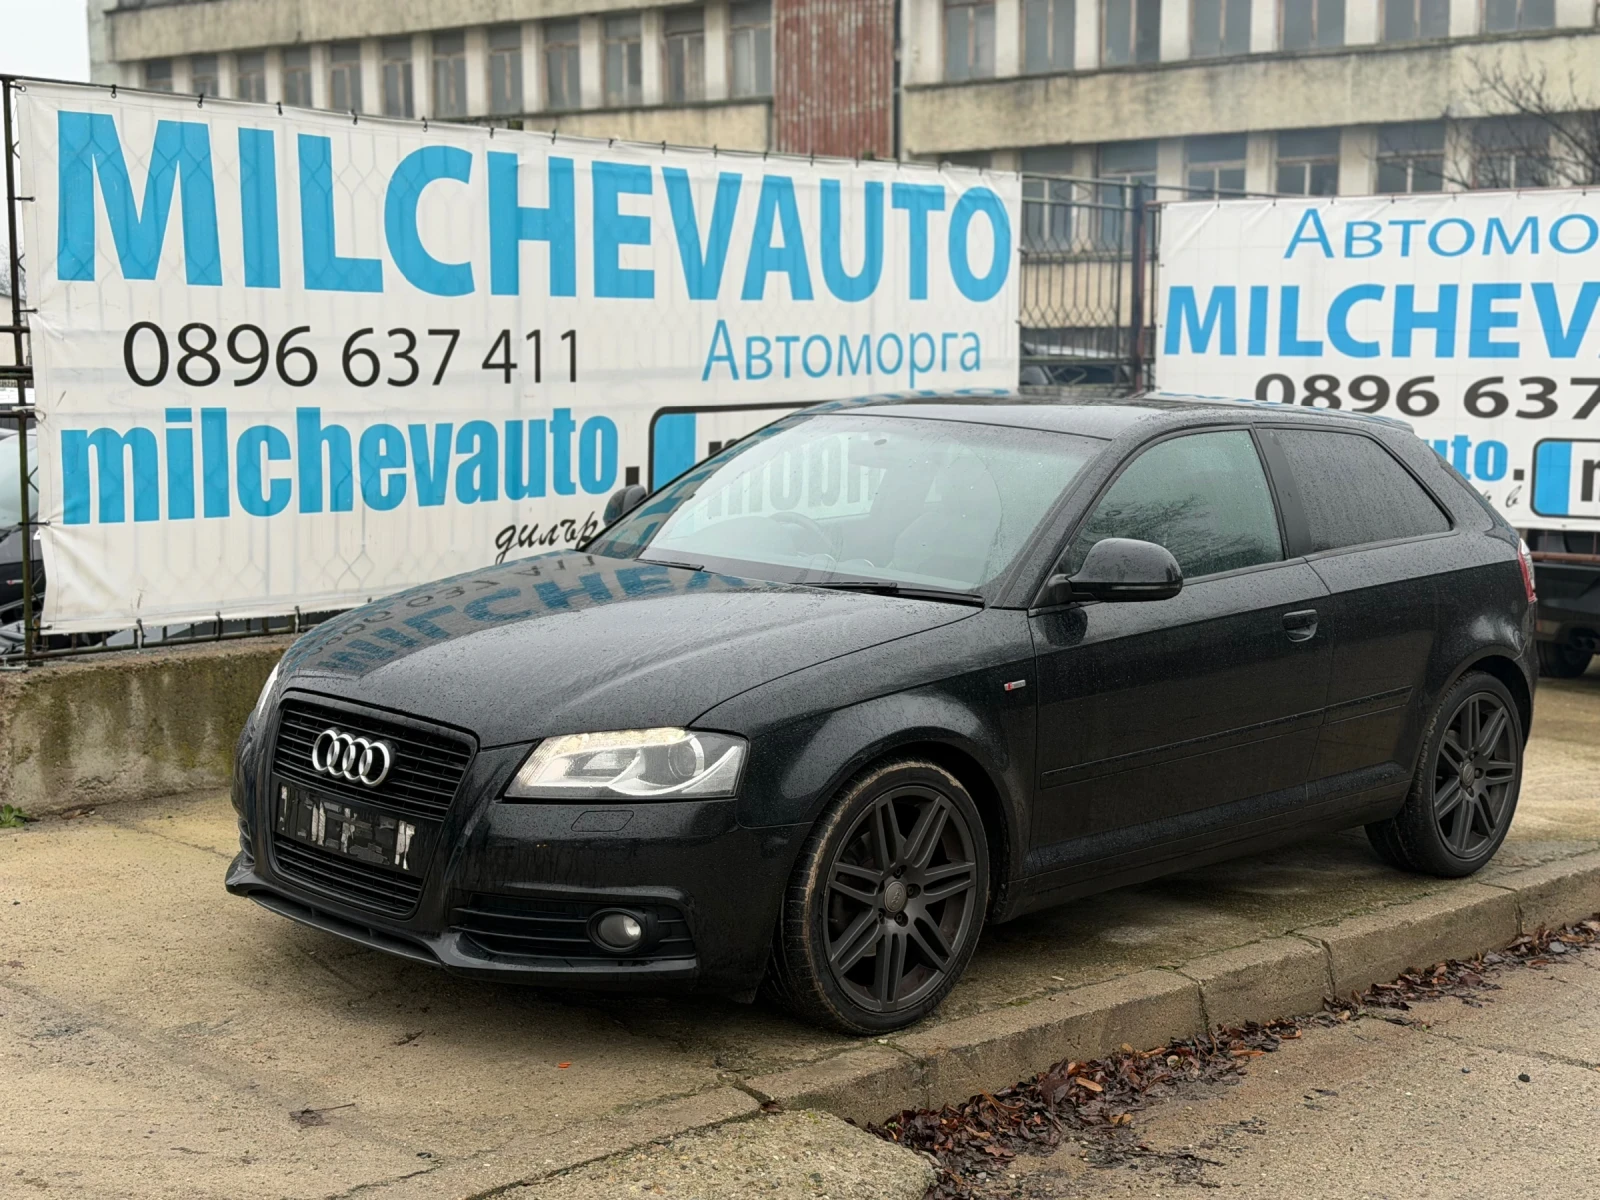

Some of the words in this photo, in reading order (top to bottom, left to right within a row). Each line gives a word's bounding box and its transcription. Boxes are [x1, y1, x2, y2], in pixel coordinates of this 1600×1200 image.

[57, 110, 1011, 302] MILCHEVAUTO
[123, 321, 318, 388] 0896
[342, 327, 460, 388] 637
[481, 329, 578, 384] 411
[701, 319, 981, 388] Автоморга
[1255, 373, 1440, 417] 0896
[1463, 376, 1600, 420] 637
[495, 510, 599, 566] дилър
